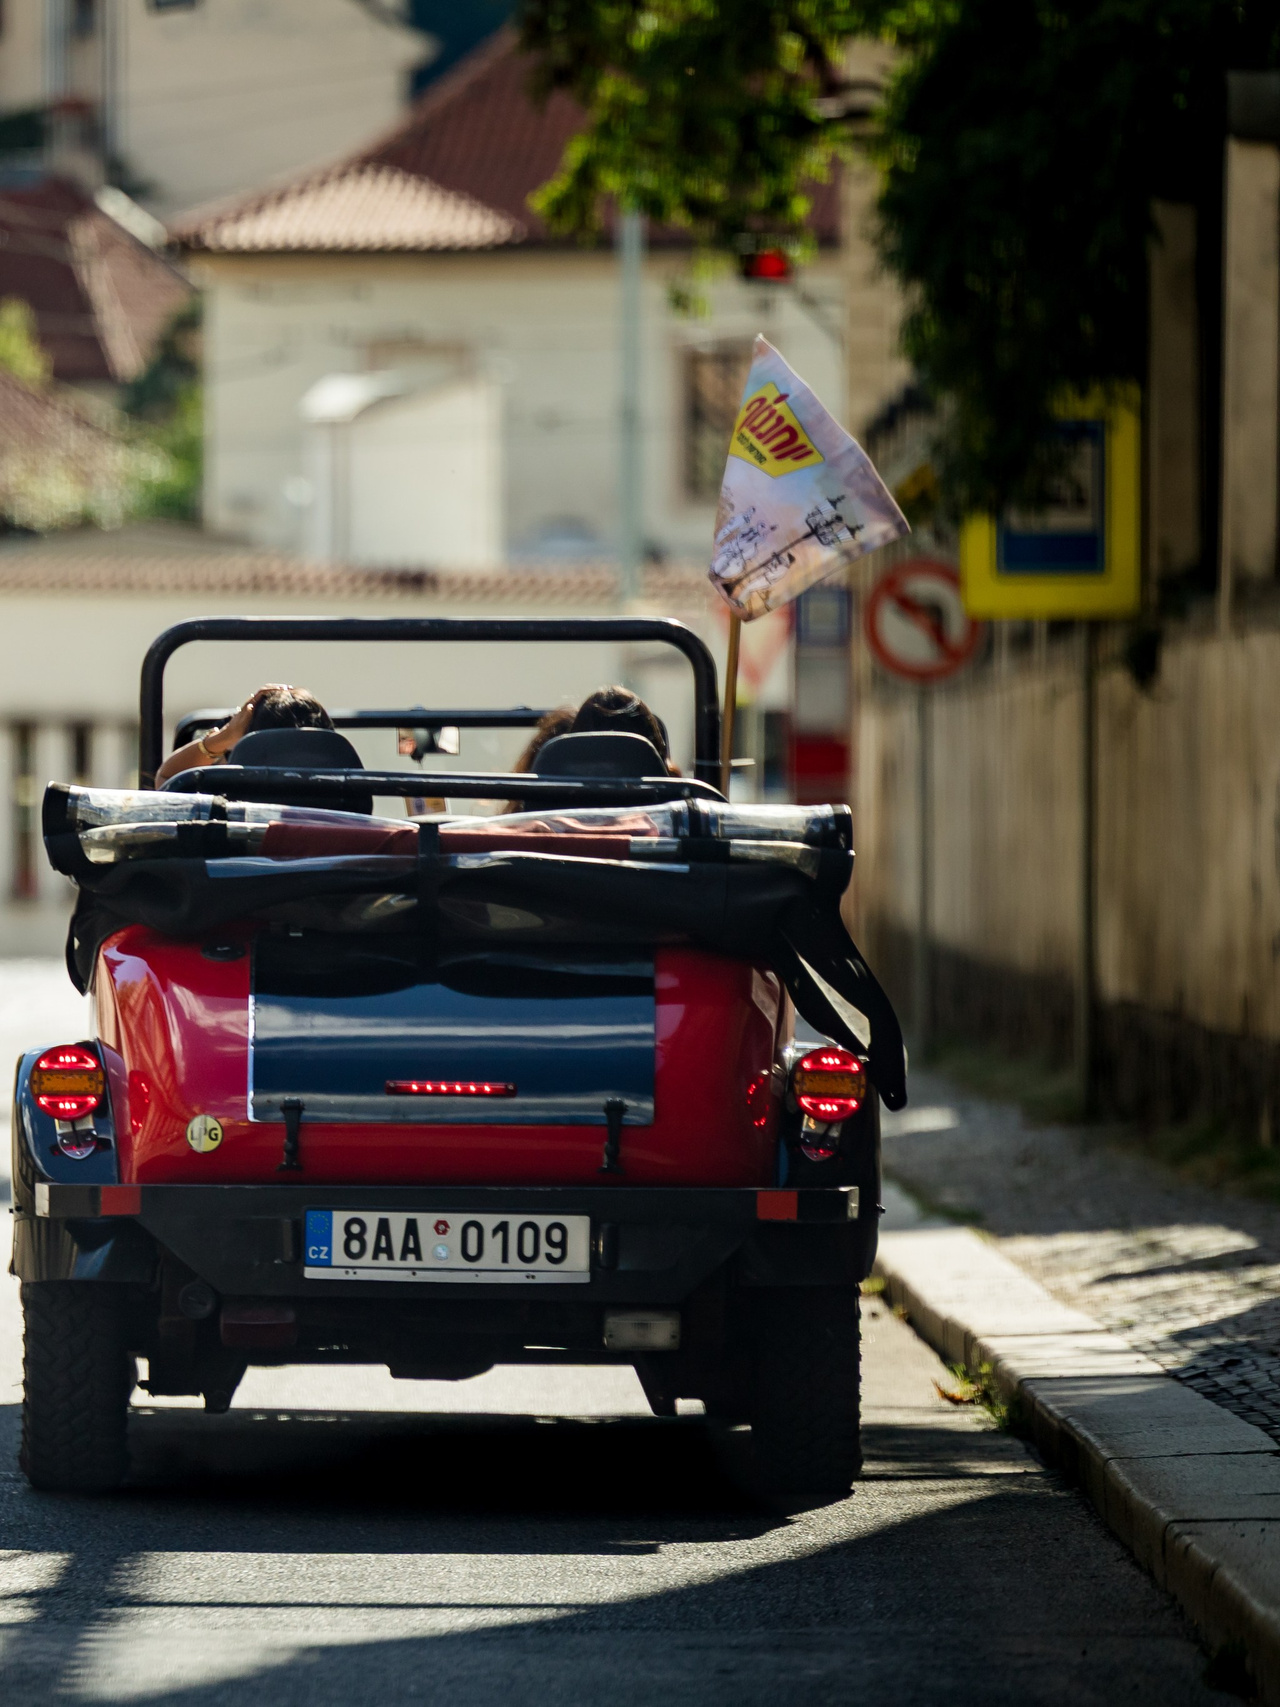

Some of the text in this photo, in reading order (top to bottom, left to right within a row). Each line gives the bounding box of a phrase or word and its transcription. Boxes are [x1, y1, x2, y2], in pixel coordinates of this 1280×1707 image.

[308, 1246, 329, 1259] CZ
[343, 1216, 569, 1265] 8AA 0109
